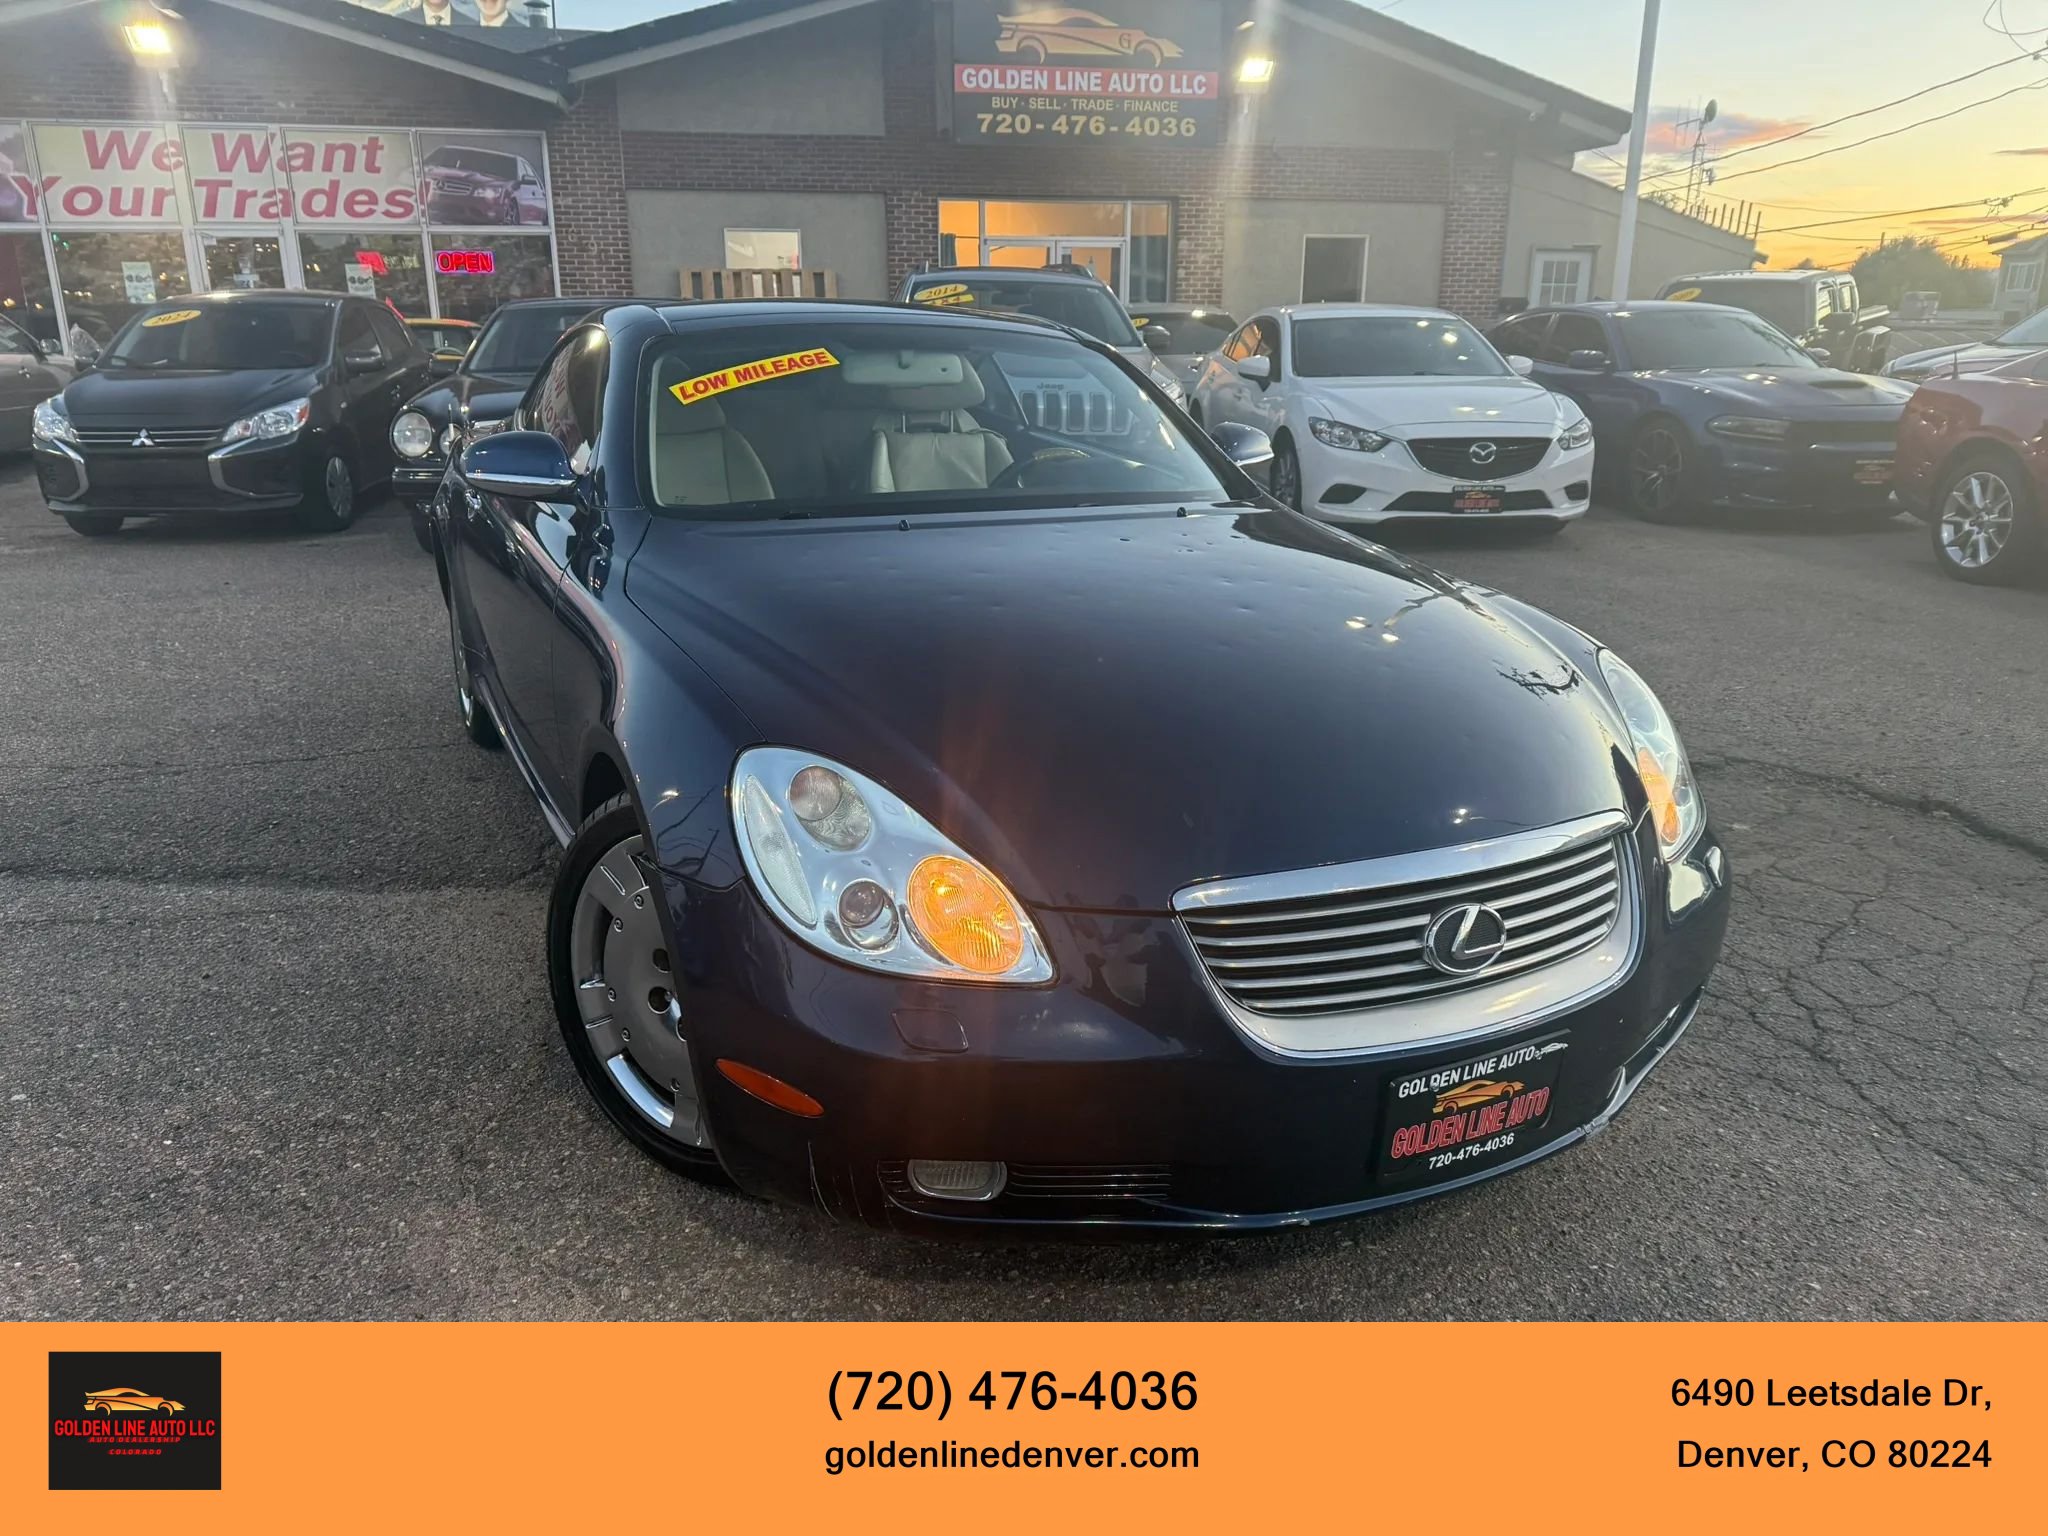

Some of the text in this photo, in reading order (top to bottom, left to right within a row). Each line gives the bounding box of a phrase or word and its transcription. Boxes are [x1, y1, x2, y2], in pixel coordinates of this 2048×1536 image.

[962, 68, 1206, 94] GOLDEN LINE AUTO LLC
[991, 96, 1179, 112] BUY SELL TRADE FINANCE
[82, 129, 385, 174] We Want
[10, 175, 432, 219] Your Trades!
[438, 252, 494, 273] OPEN
[926, 285, 958, 298] 2014
[678, 352, 830, 400] LOW MILEAGE
[1399, 1045, 1535, 1098] GOLDEN LINE AUTO
[1391, 1086, 1550, 1159] GOLDEN LINE AUTO
[1429, 1132, 1514, 1170] 720-476-4036
